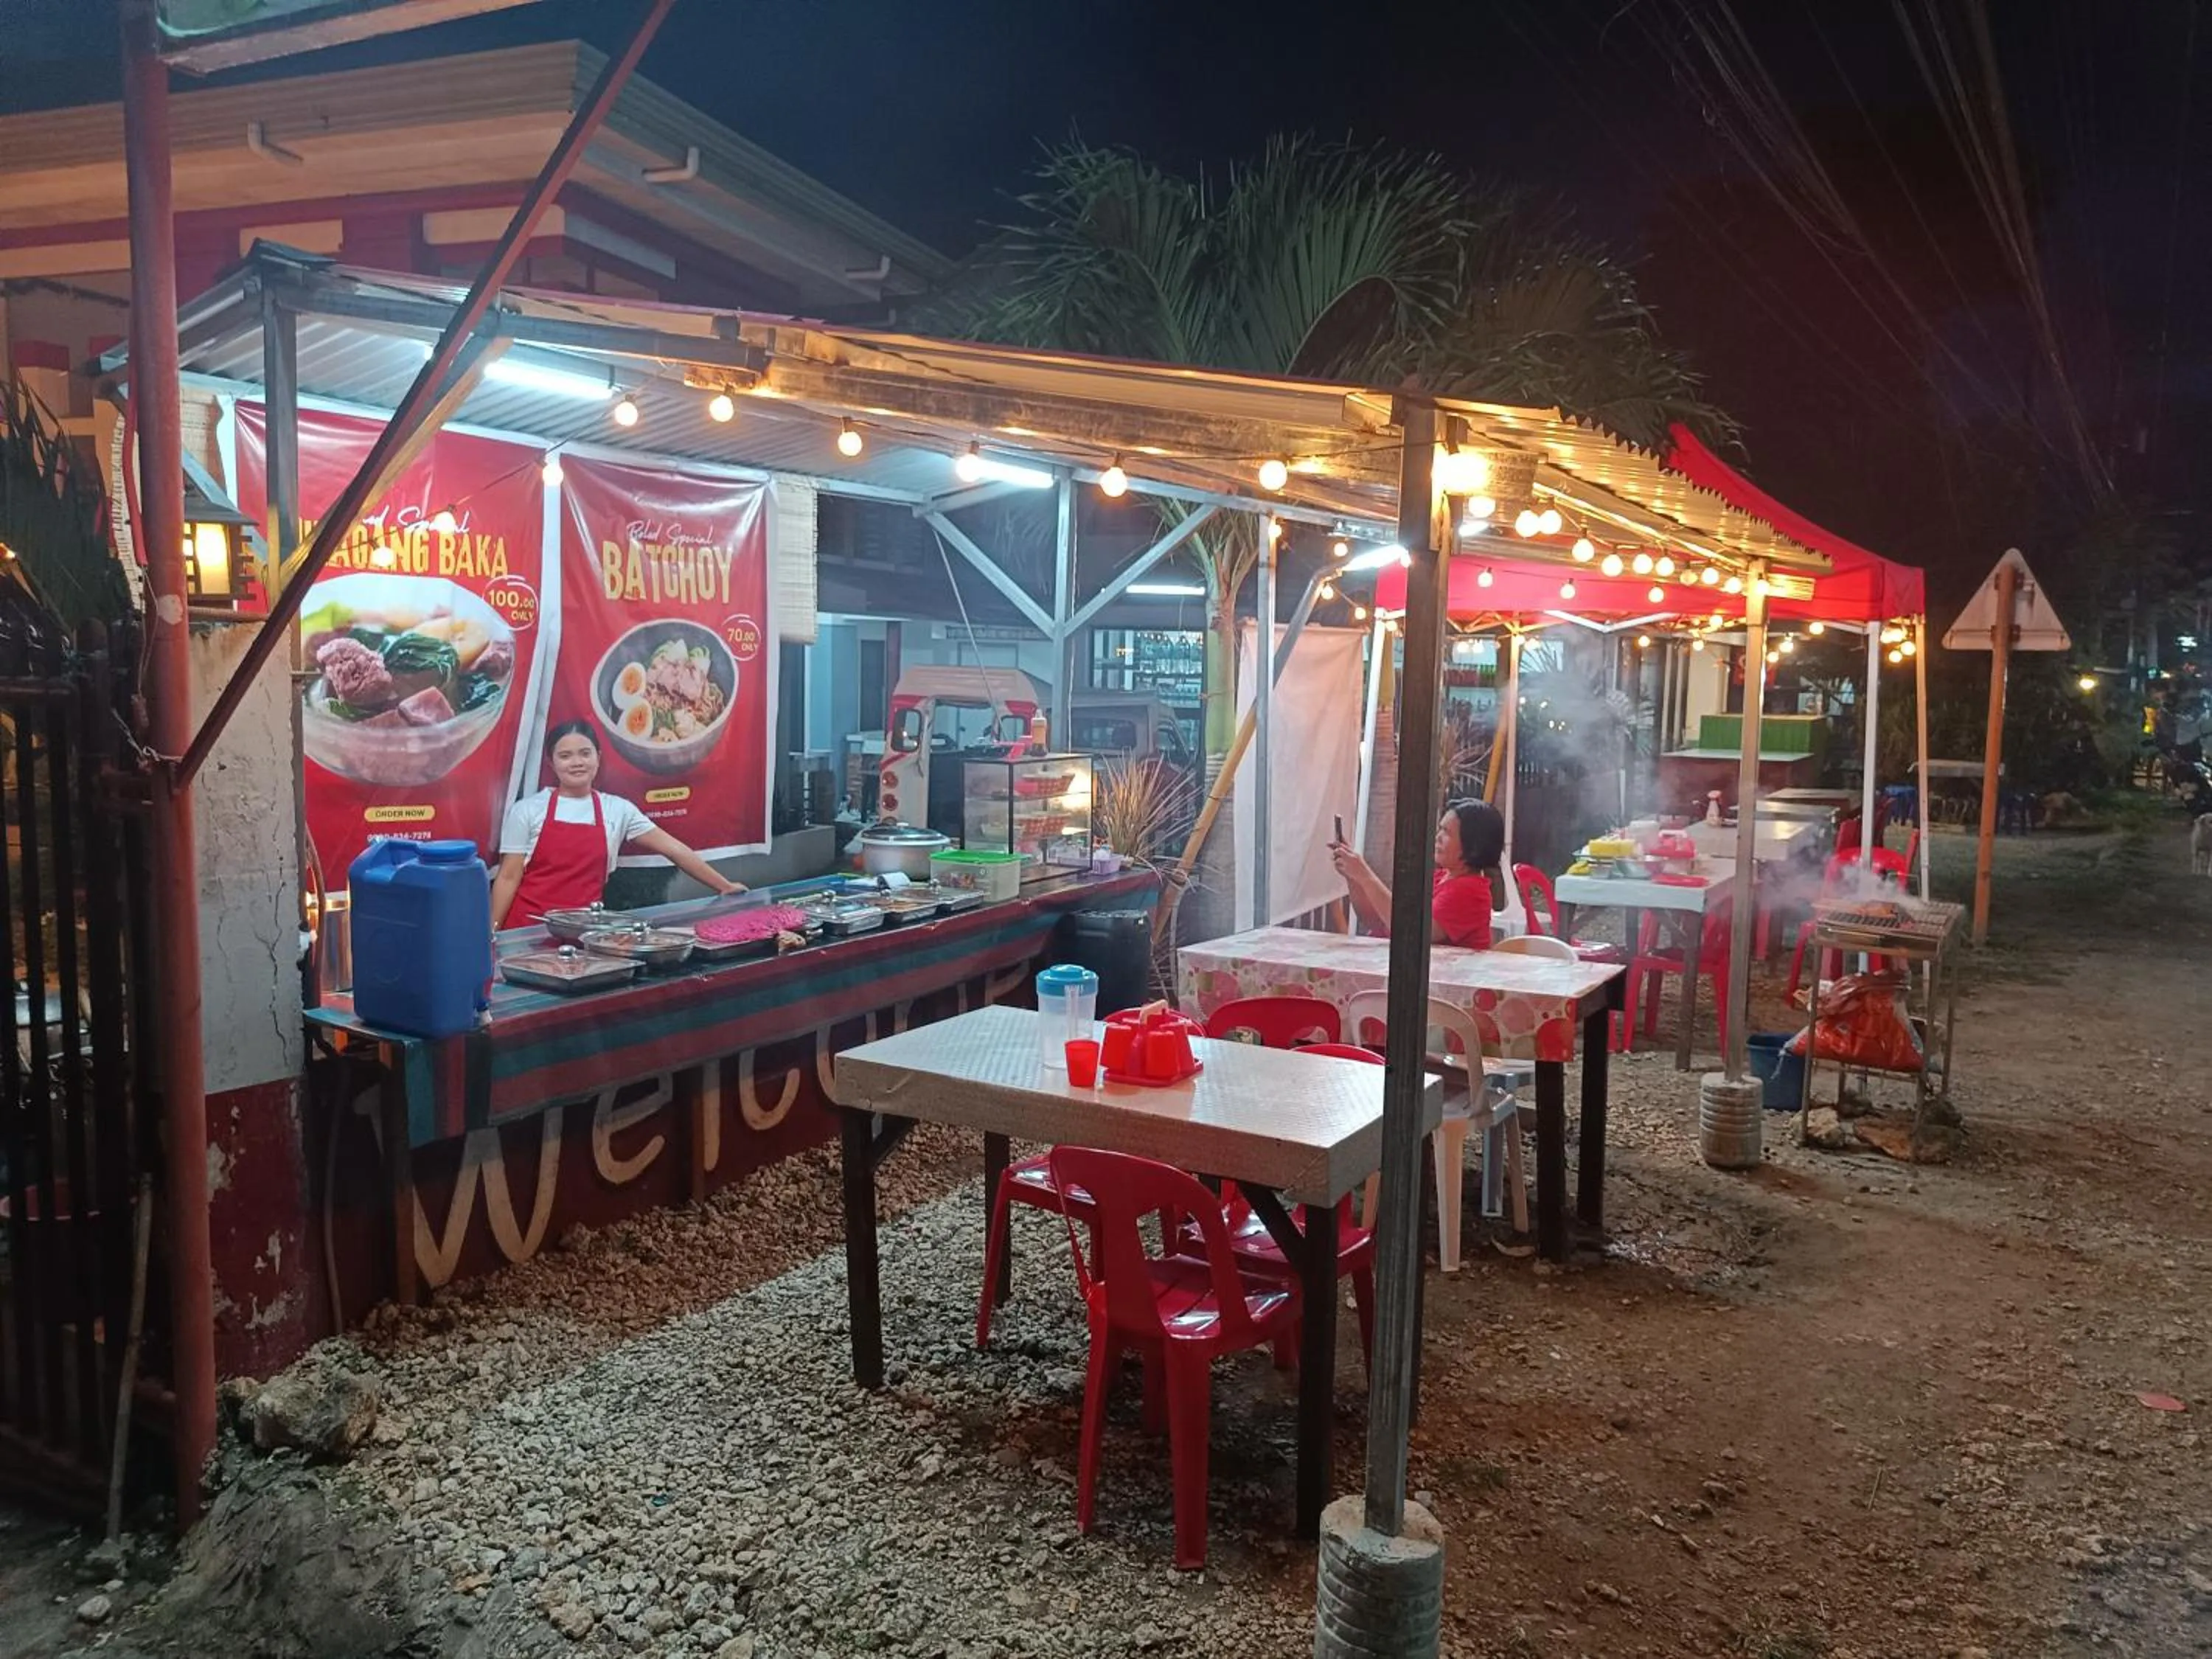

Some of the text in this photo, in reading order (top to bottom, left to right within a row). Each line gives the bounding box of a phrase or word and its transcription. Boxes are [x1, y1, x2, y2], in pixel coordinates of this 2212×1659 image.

[298, 518, 508, 580] AGANG BAKA
[666, 523, 714, 546] Special
[602, 540, 734, 605] BATCHOY
[375, 808, 425, 818] ORDER NOW
